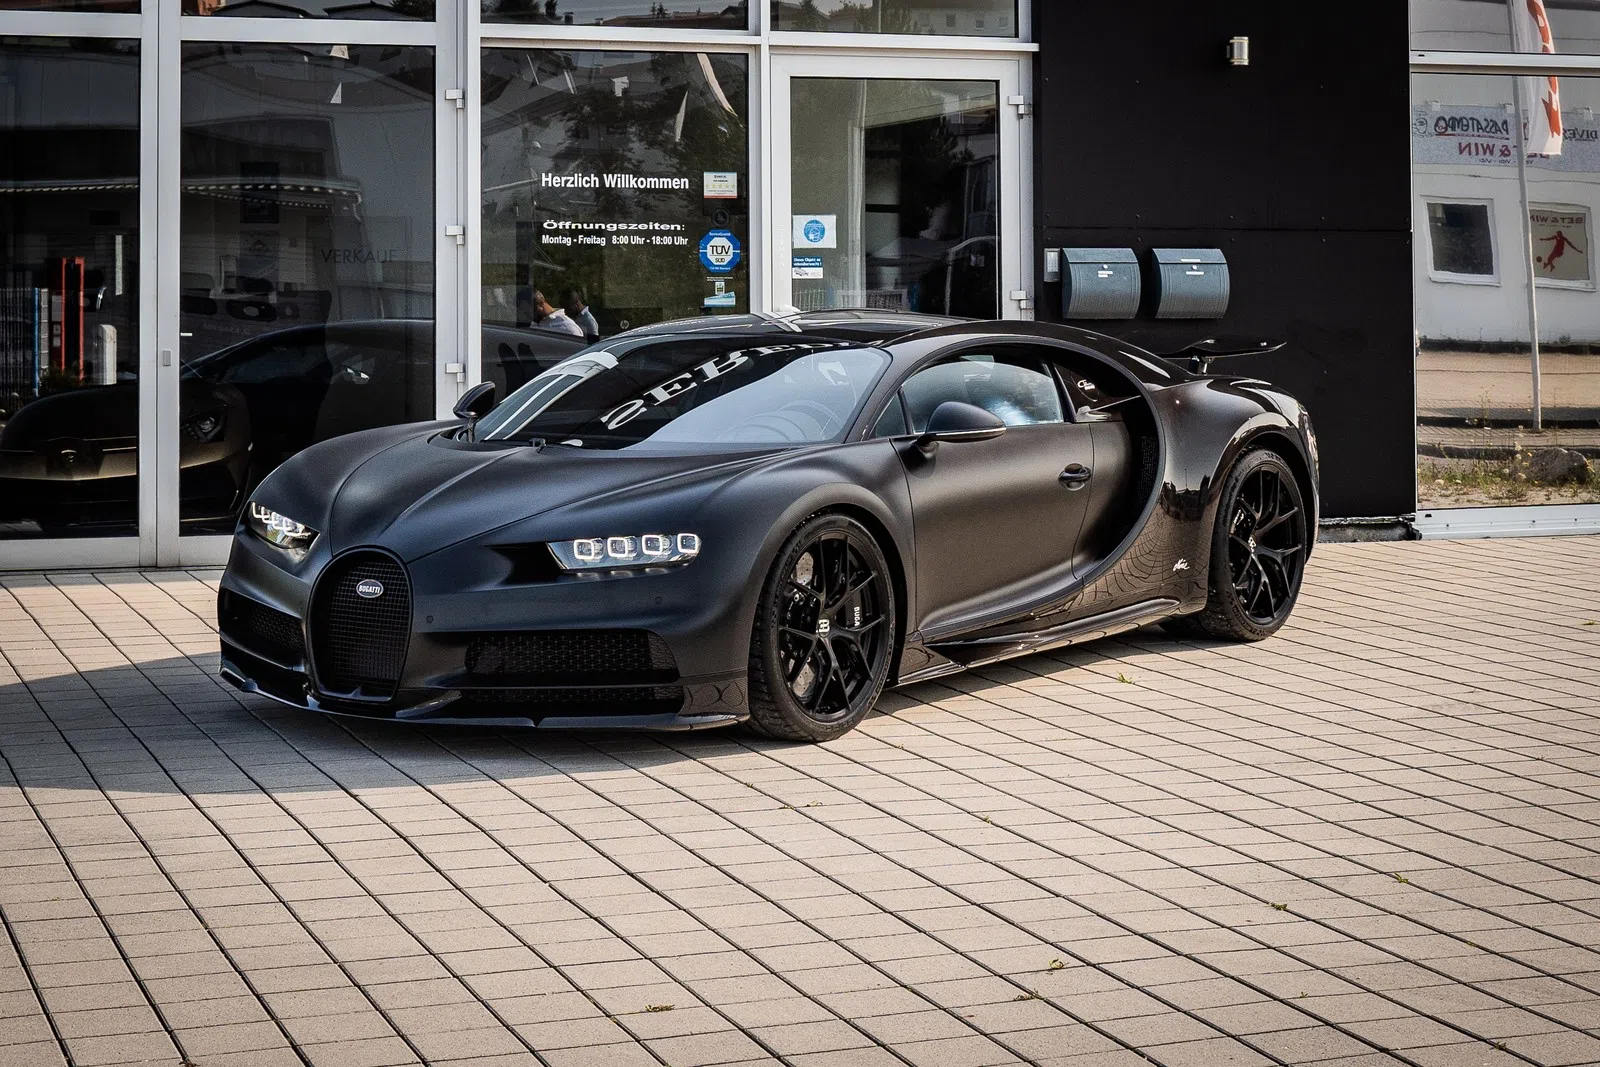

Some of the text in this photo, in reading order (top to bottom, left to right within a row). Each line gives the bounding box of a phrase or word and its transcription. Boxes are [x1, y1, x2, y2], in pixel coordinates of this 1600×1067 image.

[541, 173, 689, 189] Herzlich Willkommen
[543, 219, 685, 231] Öffnungszeiten:
[541, 235, 571, 246] Montag
[578, 235, 606, 247] Freitag
[611, 235, 629, 245] 8:00
[630, 235, 645, 245] Uhr
[651, 236, 672, 245] 18:00
[674, 236, 688, 246] Uhr
[320, 249, 397, 263] VERKAUF
